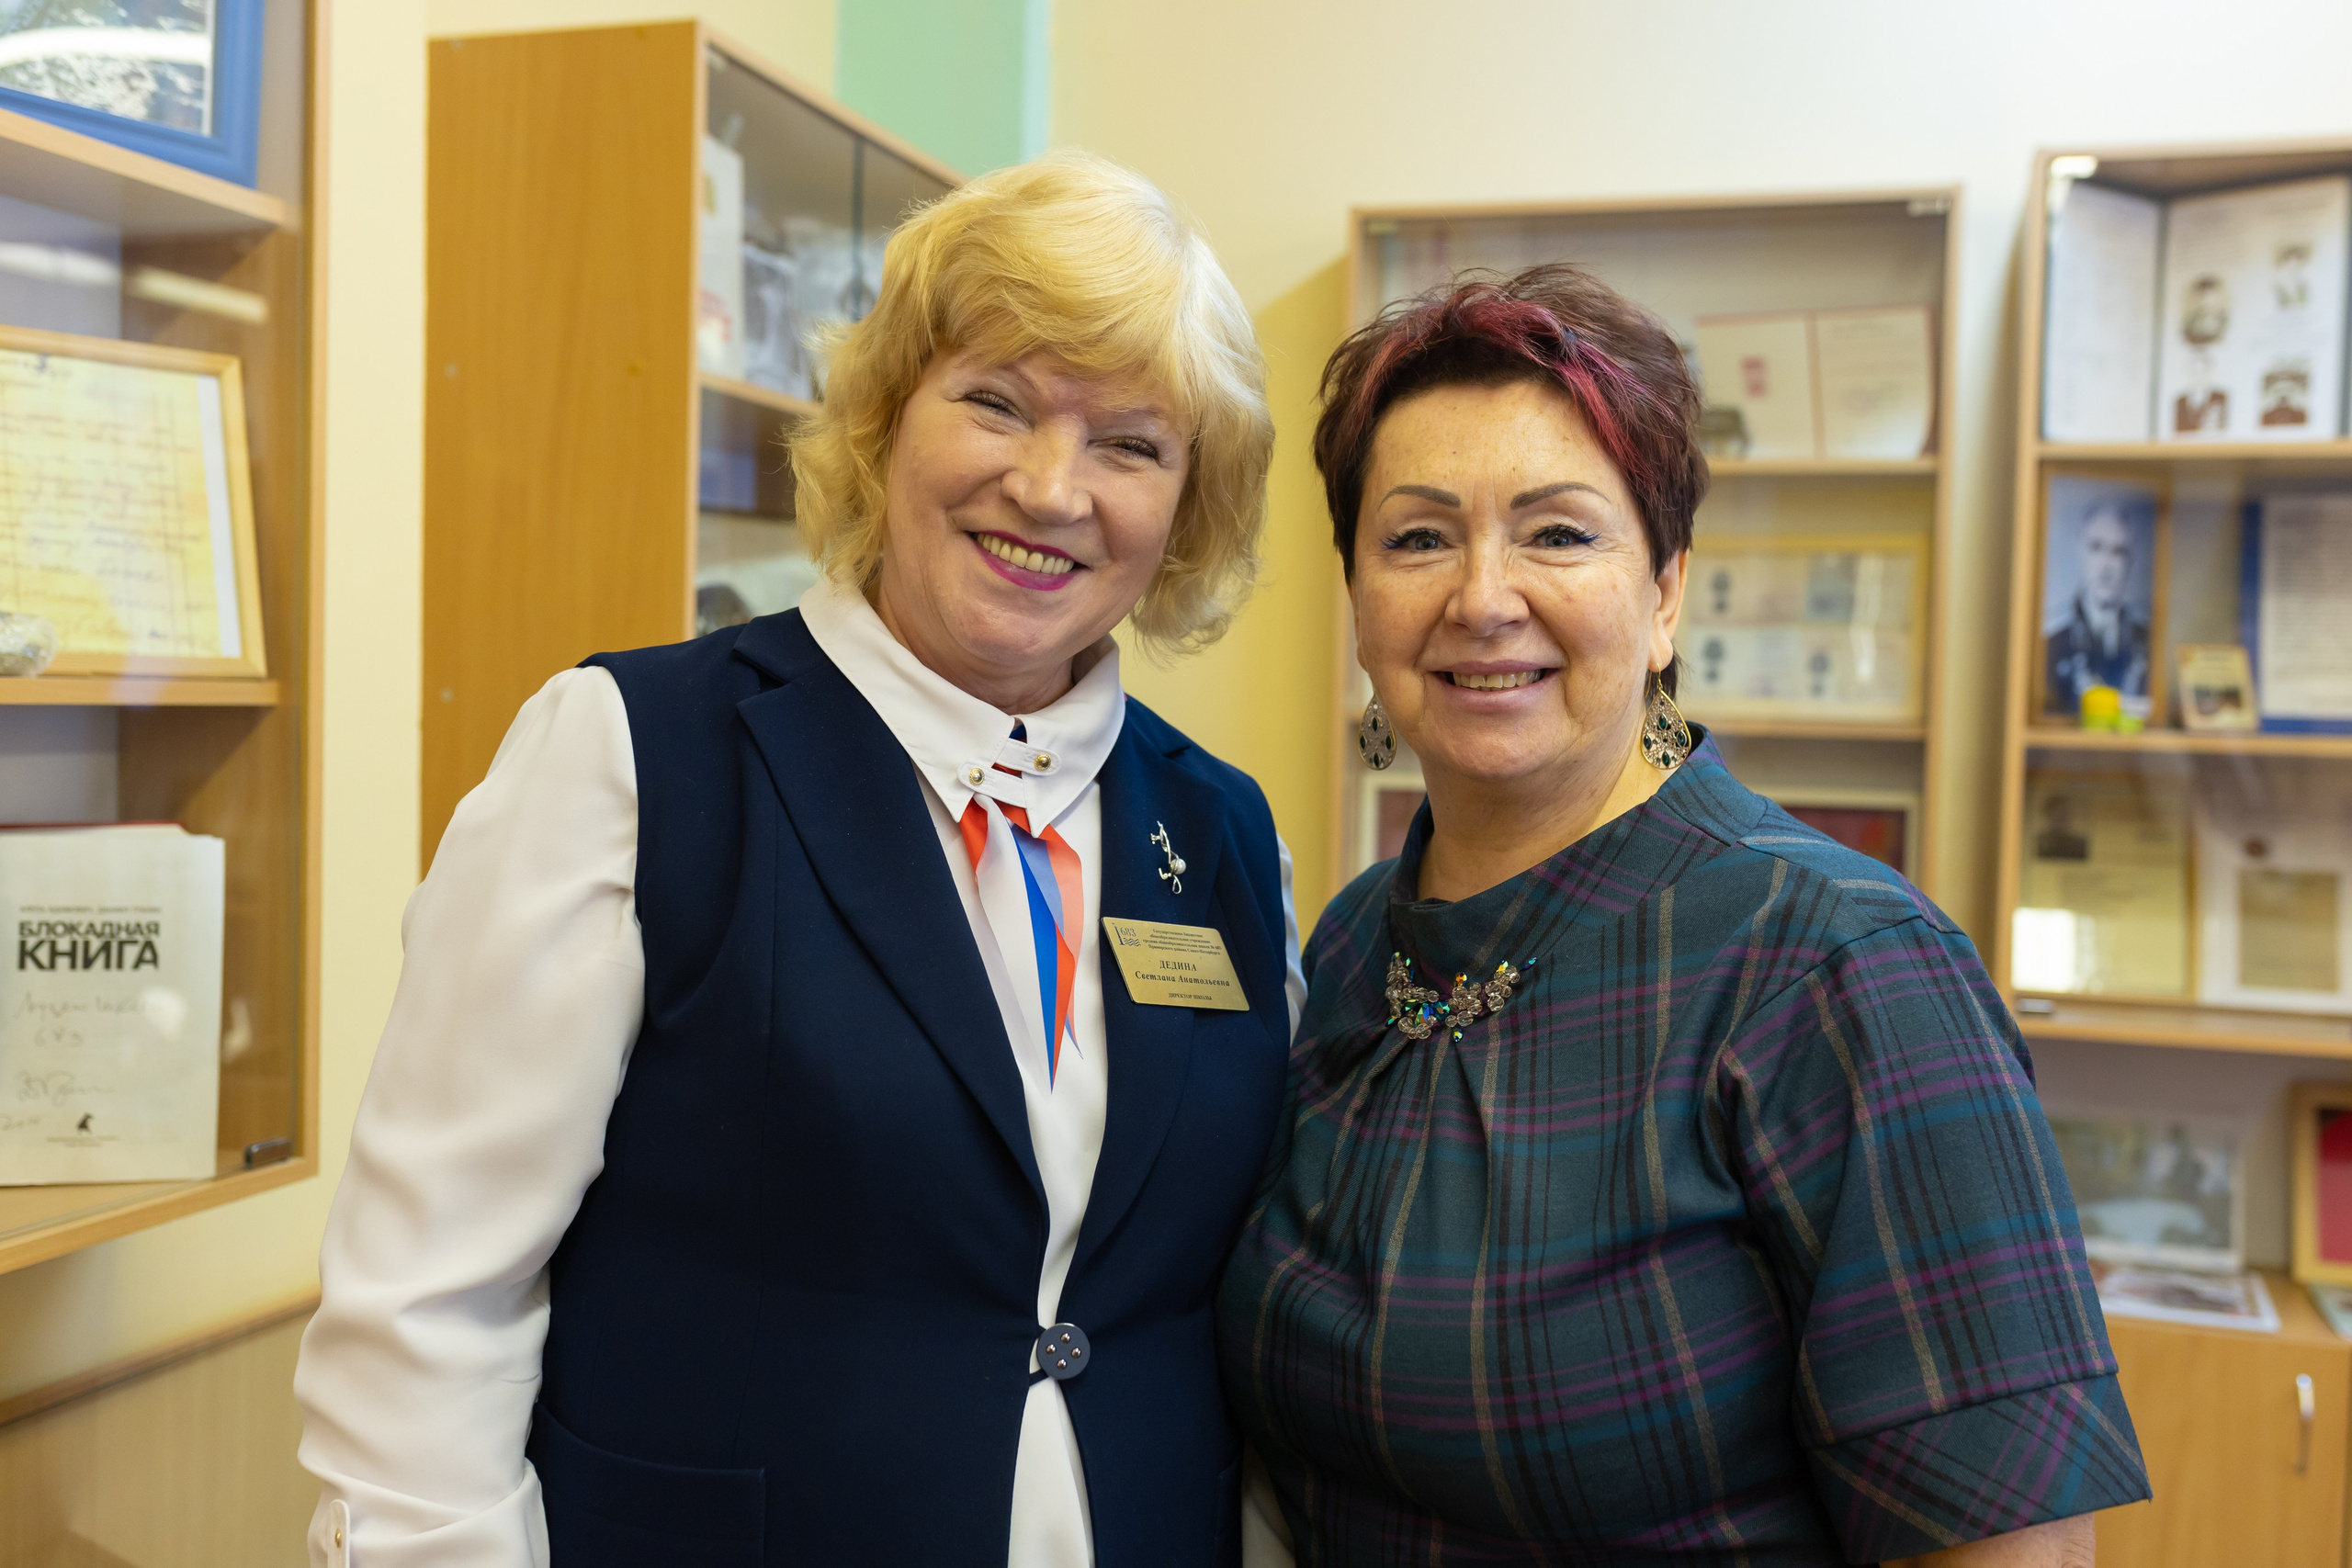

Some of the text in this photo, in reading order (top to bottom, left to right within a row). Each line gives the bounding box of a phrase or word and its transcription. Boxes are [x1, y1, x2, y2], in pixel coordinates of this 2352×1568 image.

[18, 920, 160, 938] БЛОКАДНАЯ
[1120, 927, 1136, 937] 683
[17, 939, 160, 971] КНИГА
[1159, 960, 1197, 971] ДЕДИНА
[1135, 970, 1230, 987] Светлана Анатольевна
